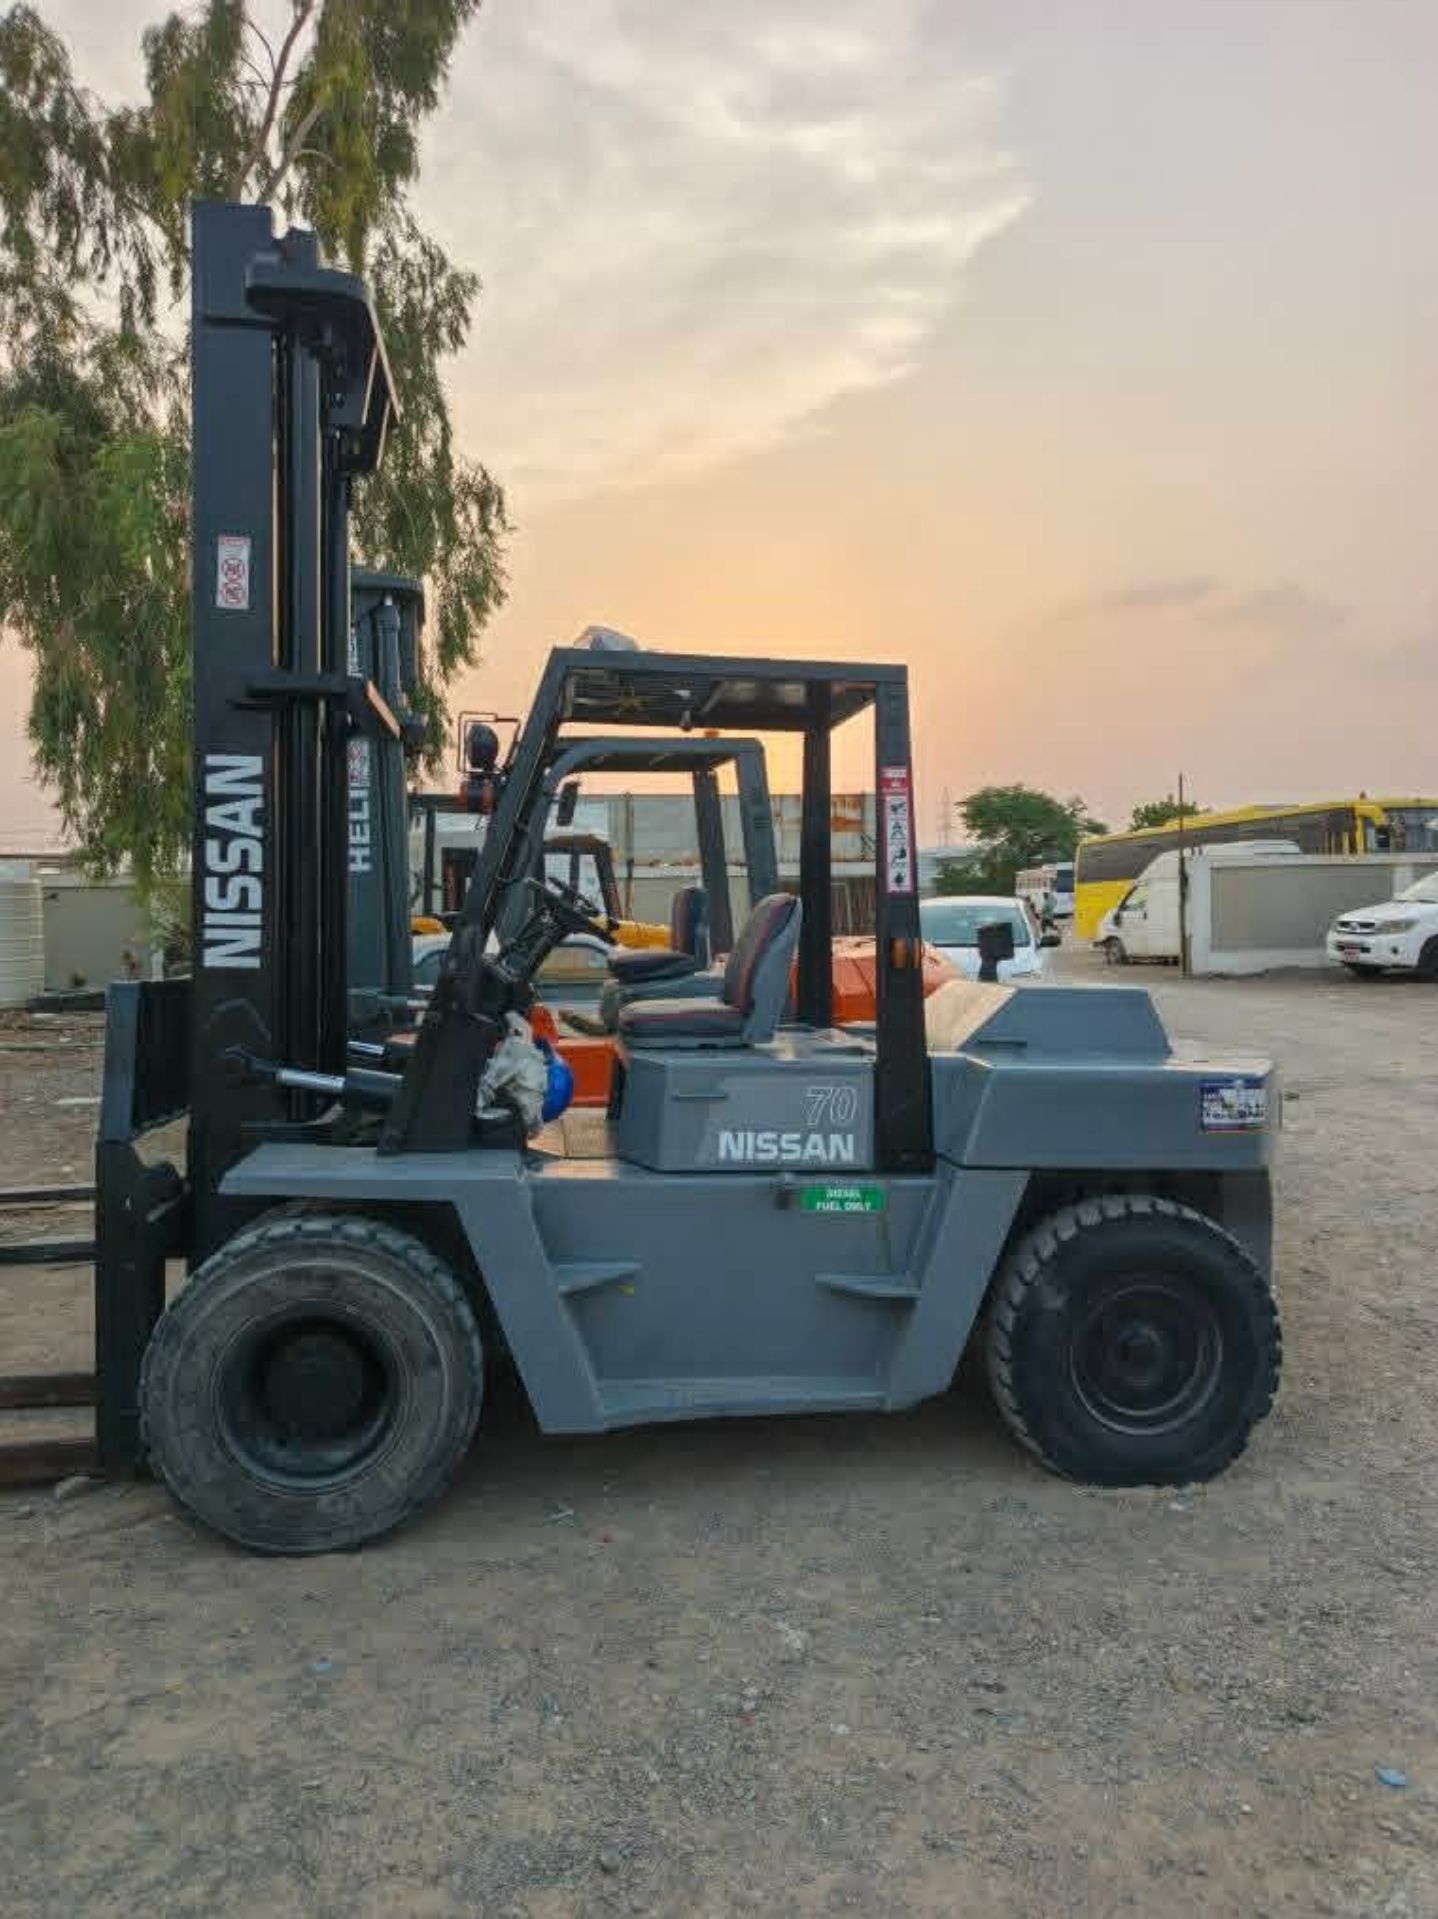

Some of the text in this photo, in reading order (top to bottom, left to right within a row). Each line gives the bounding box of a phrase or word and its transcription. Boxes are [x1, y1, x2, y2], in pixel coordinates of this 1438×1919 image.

[348, 788, 371, 872] HELI
[203, 753, 264, 970] NISSAN
[804, 1085, 858, 1126] 70
[717, 1131, 855, 1162] NISSAN
[816, 1201, 872, 1211] FUEL ONLY
